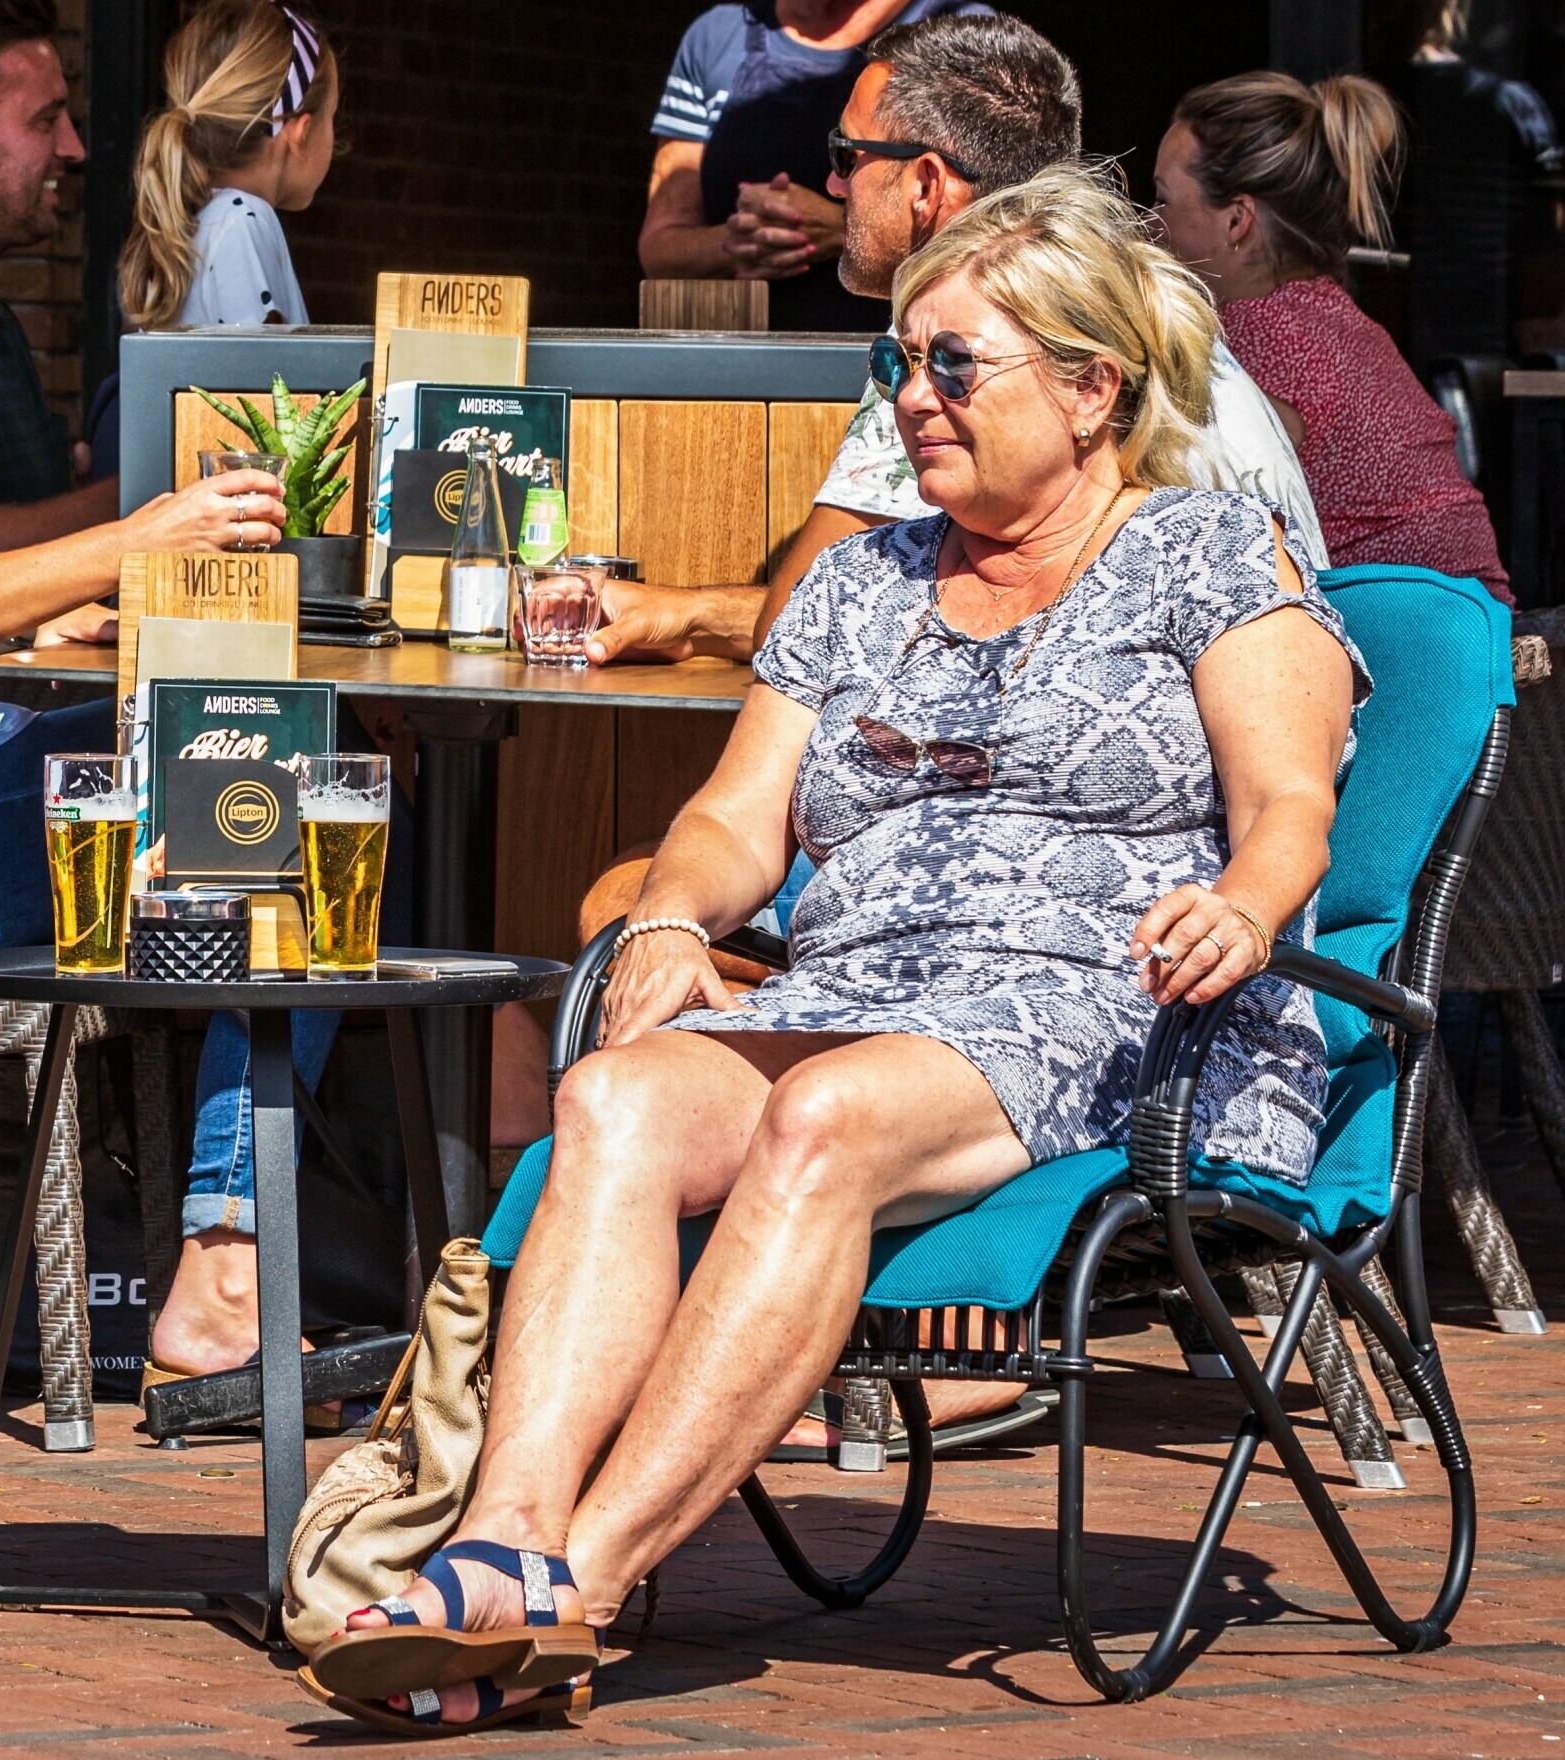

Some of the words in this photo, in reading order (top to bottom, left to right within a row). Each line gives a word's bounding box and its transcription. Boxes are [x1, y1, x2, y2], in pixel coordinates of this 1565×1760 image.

[420, 280, 502, 316] ANDERS
[458, 397, 504, 415] ANDERS
[173, 557, 269, 598] ANDERS
[203, 696, 257, 714] ANDERS
[179, 728, 269, 760] Bier
[231, 808, 264, 818] Lipton
